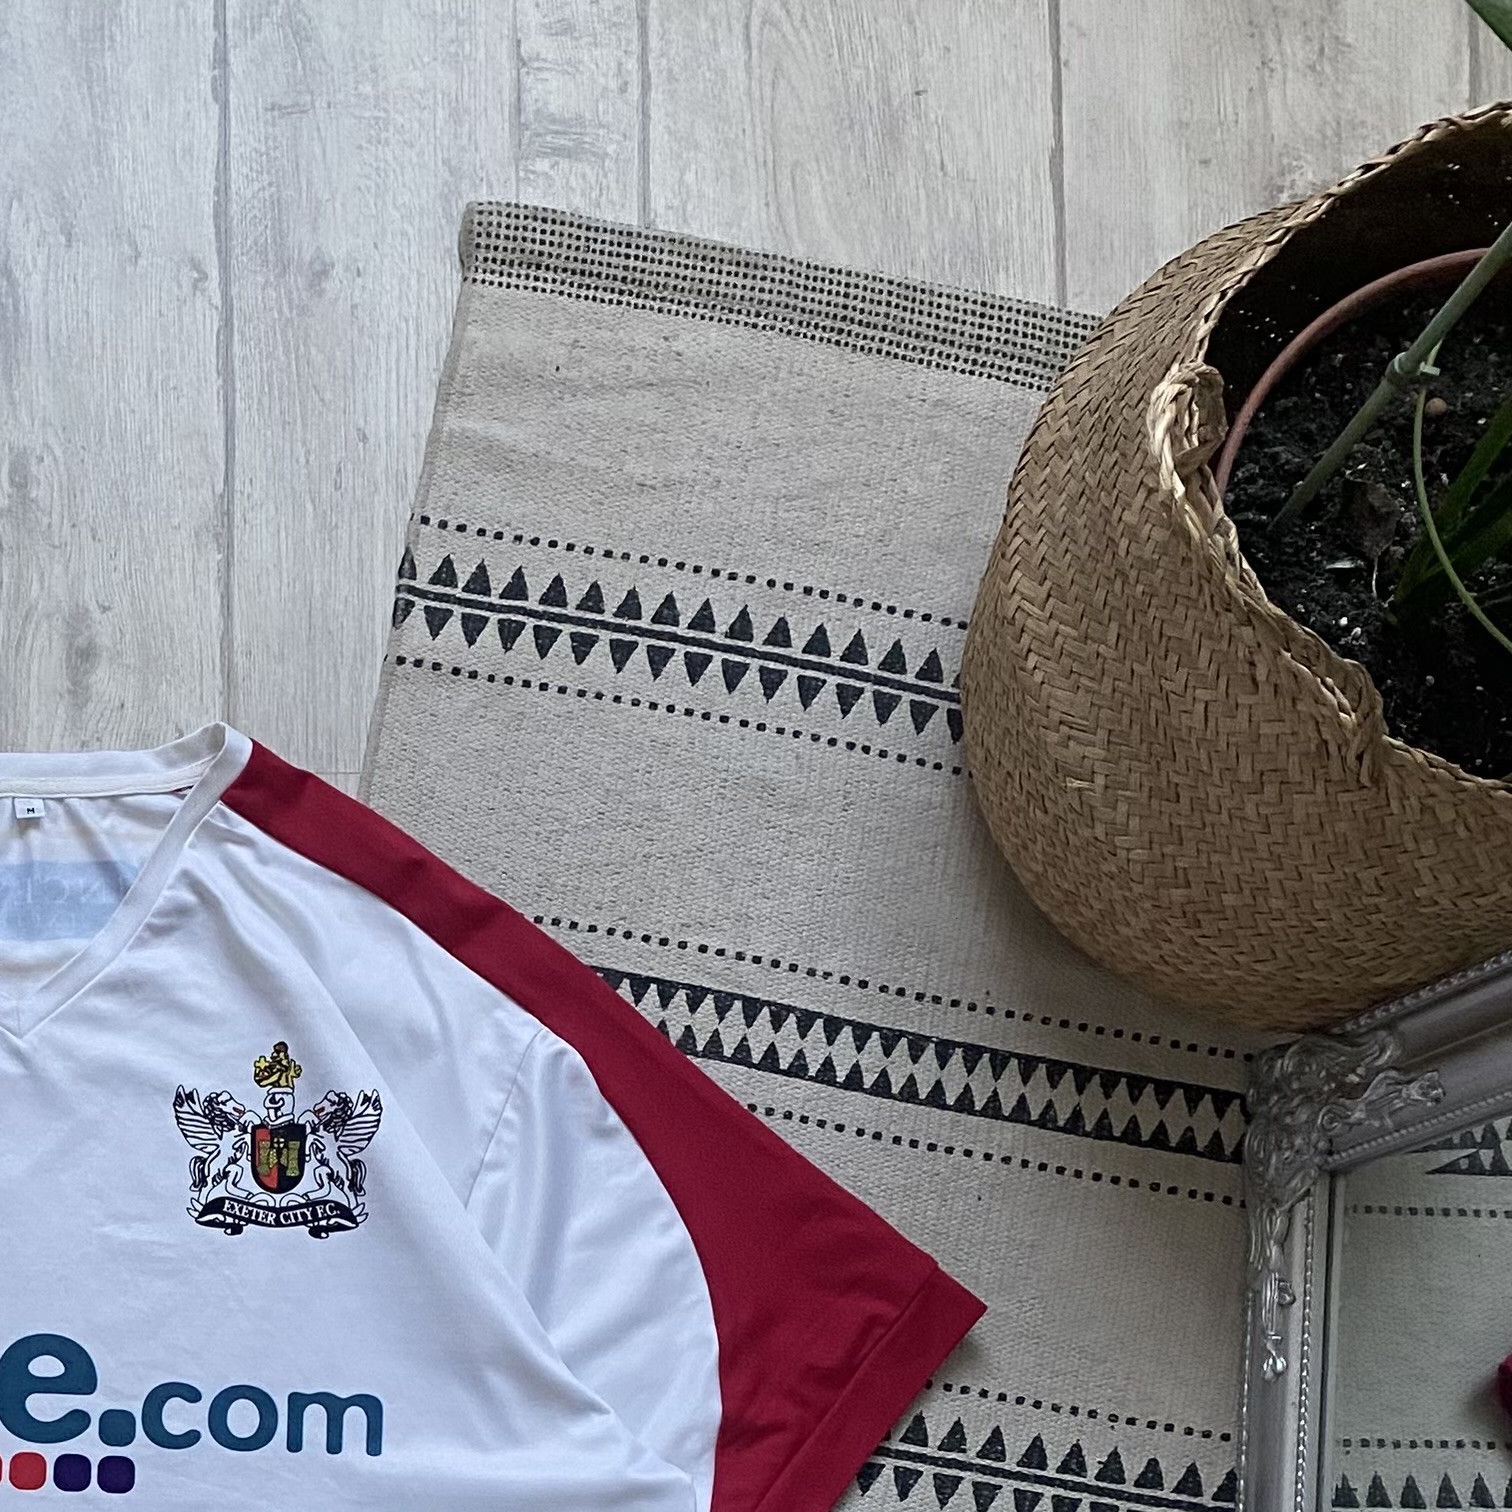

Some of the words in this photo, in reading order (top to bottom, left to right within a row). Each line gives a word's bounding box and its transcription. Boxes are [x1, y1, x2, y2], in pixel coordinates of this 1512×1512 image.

[223, 1200, 276, 1225] EXETER
[279, 1207, 313, 1225] CITY
[316, 1202, 340, 1218] F.C.
